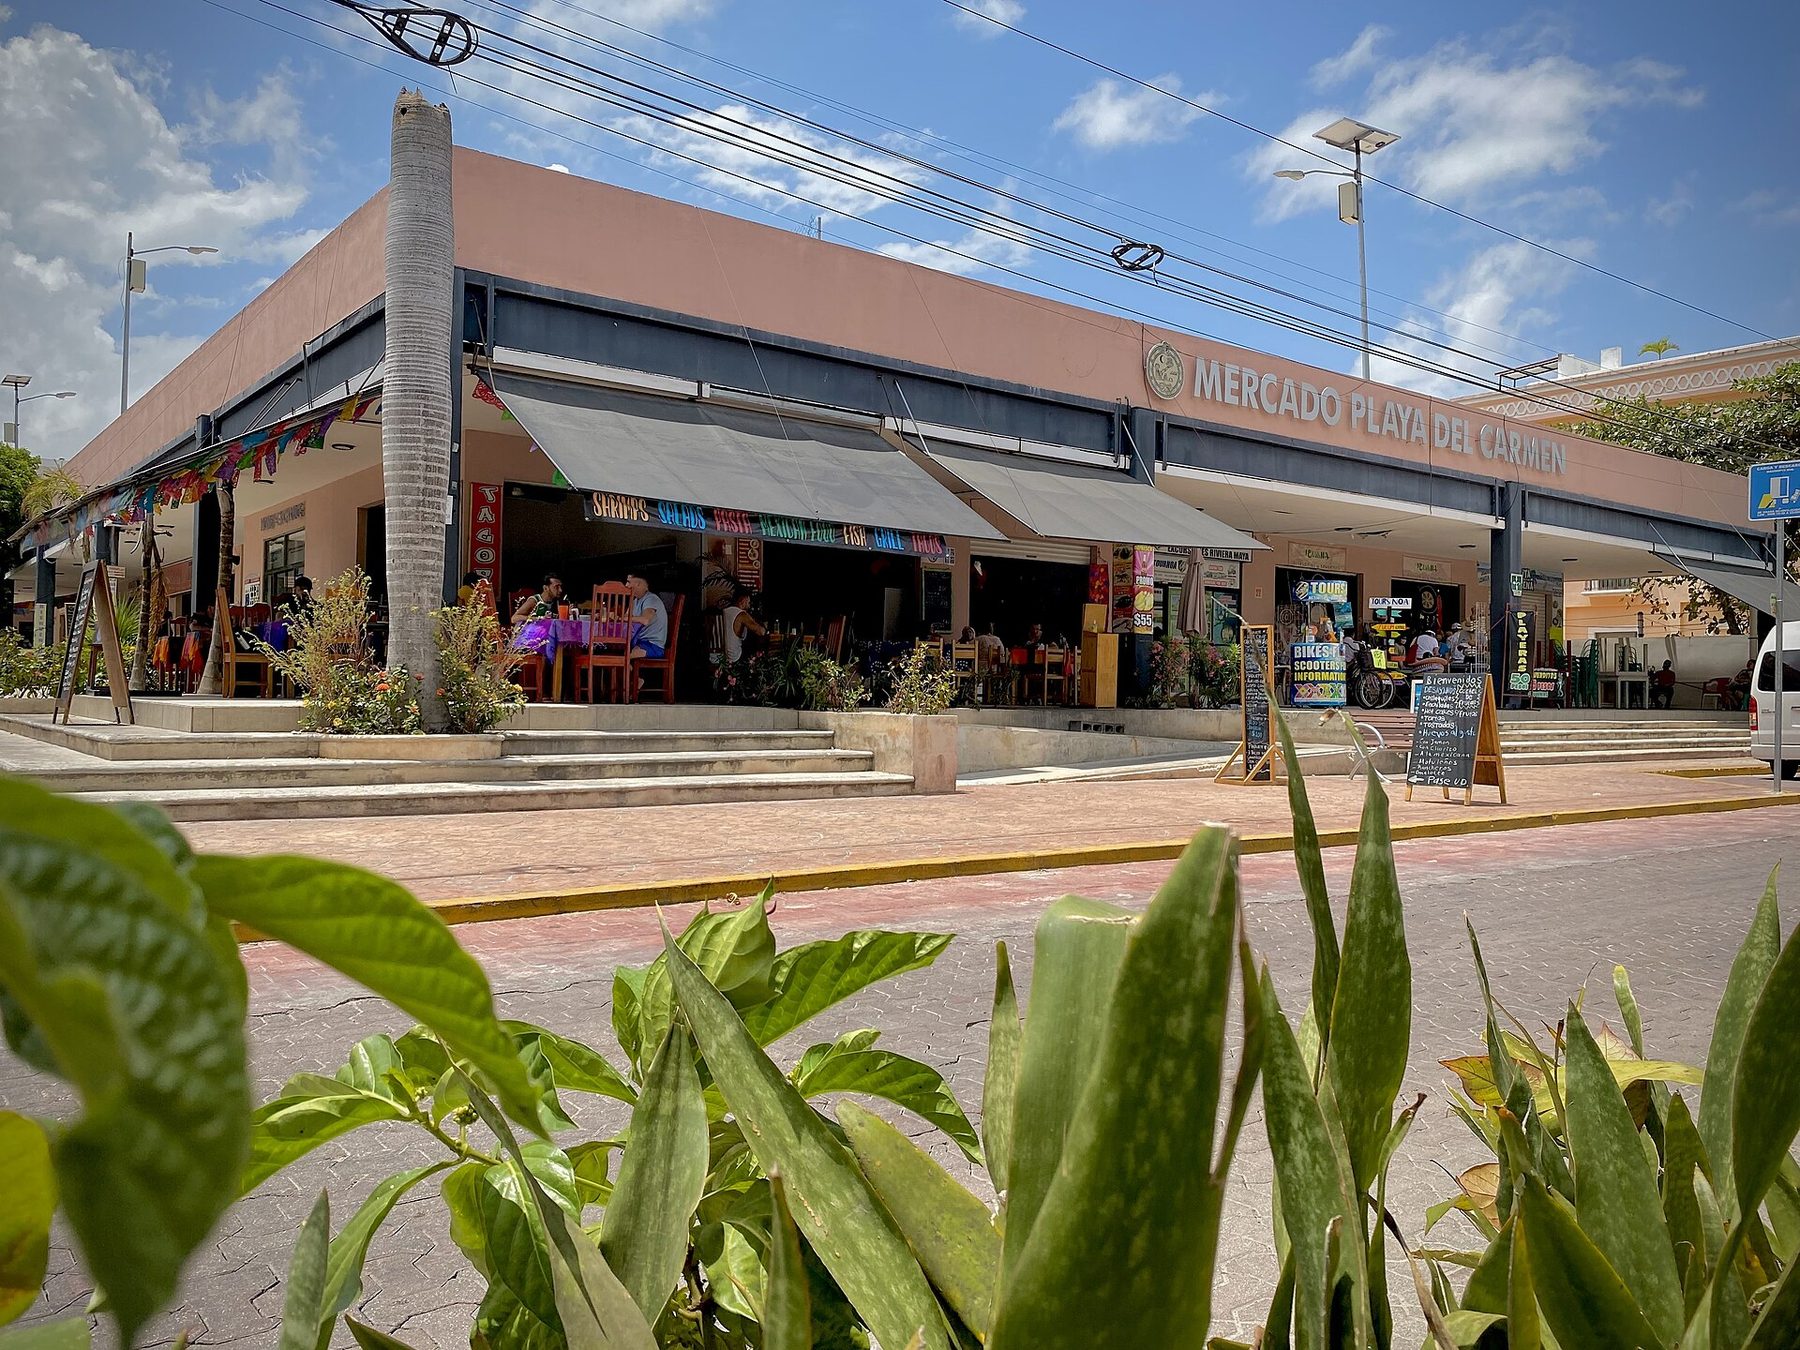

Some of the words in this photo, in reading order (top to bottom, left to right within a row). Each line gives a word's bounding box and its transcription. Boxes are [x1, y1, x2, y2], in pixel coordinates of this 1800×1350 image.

[1193, 356, 1341, 427] MERCADO
[1351, 392, 1427, 446] PLAYA
[1434, 412, 1474, 455] DEL
[1479, 423, 1567, 475] CARMEN
[592, 491, 650, 522] SHRIMPS
[657, 501, 708, 530] SALADS
[713, 508, 753, 534] PASTA
[758, 514, 807, 541] MEXICAN
[810, 520, 836, 543] FOOD
[843, 524, 867, 547] FISH
[873, 527, 905, 550] GRILL
[911, 532, 943, 554] TACOS
[1209, 548, 1233, 560] RIVIERA
[1233, 551, 1250, 561] MAYA
[1310, 581, 1346, 595] TOURS
[1391, 598, 1409, 606] NOA
[1133, 612, 1152, 627] $55
[1516, 611, 1529, 673] PLAYERAS
[1294, 645, 1330, 659] BIKES
[1294, 660, 1340, 671] SCOOTERS
[1426, 675, 1482, 686] Bienvenidos
[1509, 672, 1531, 685] 50
[1427, 775, 1451, 786] Pase
